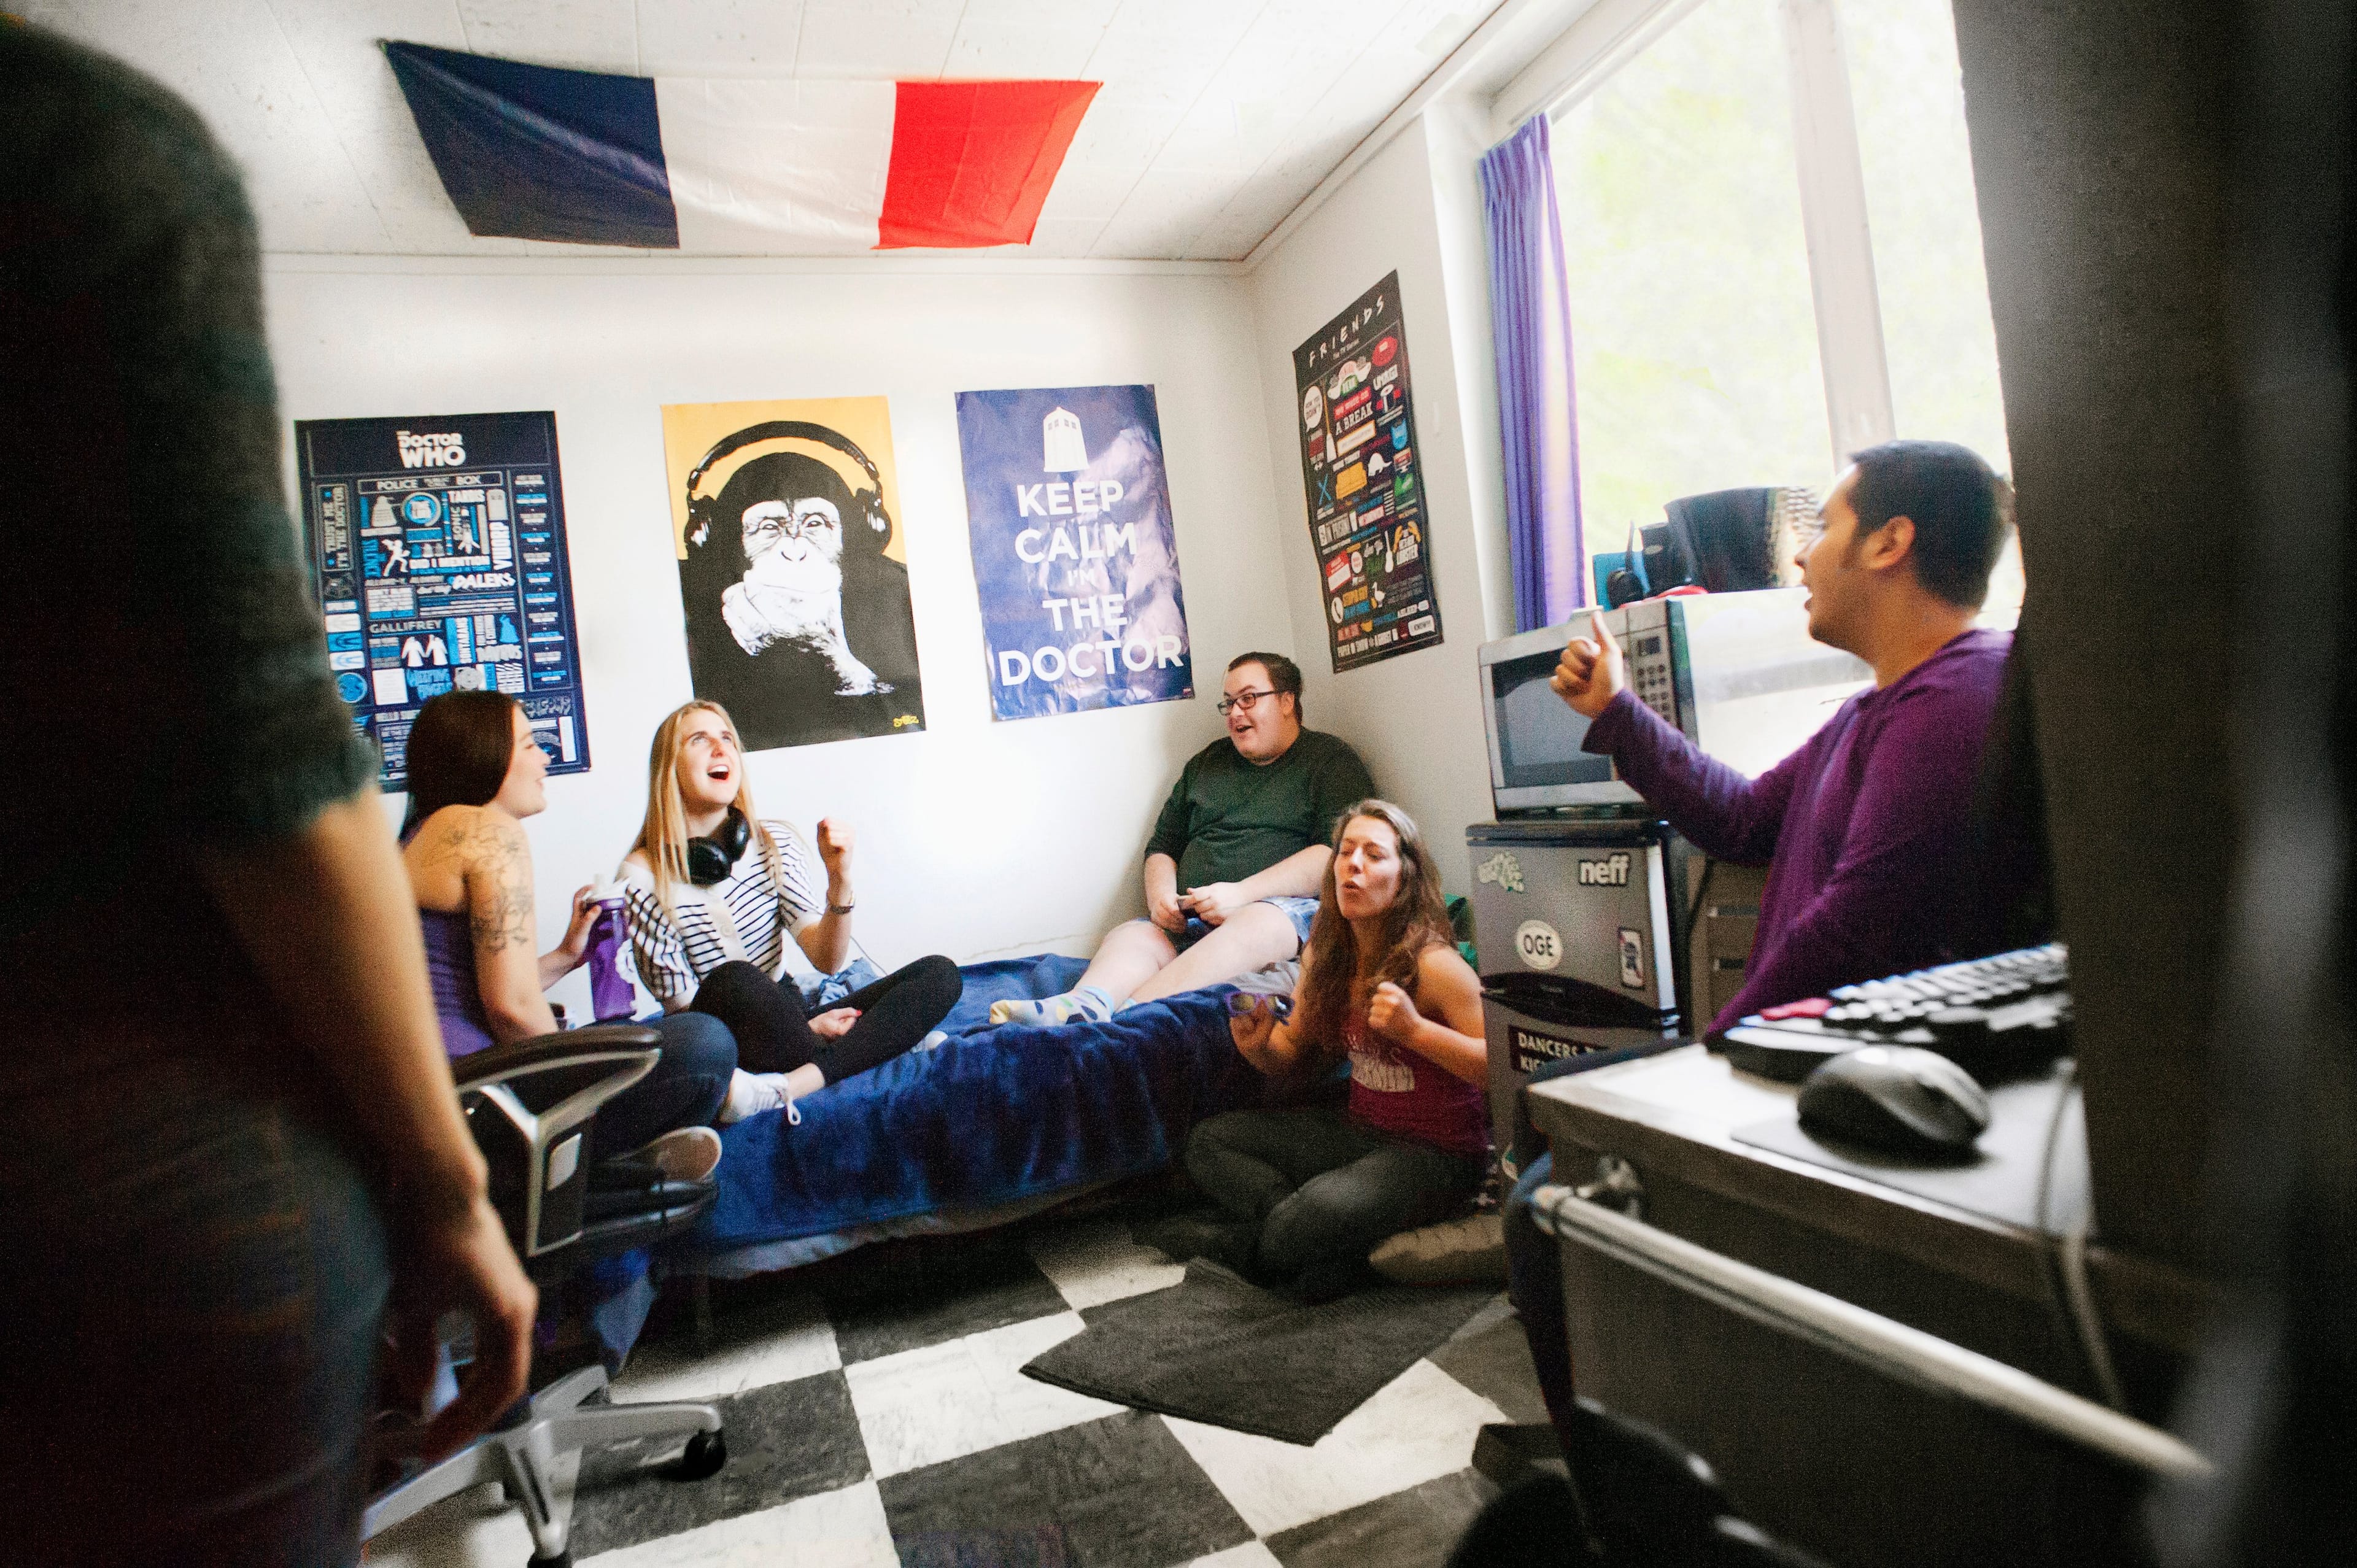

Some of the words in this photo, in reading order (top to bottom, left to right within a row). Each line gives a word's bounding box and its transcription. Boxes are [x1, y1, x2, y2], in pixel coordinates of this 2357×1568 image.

[1309, 295, 1385, 368] FRIENDS
[1336, 422, 1342, 435] A
[1343, 401, 1374, 430] BREAK
[397, 433, 463, 448] DOCTOR
[399, 446, 466, 468] WHO
[377, 479, 419, 492] POLICE
[456, 476, 481, 485] BOX
[1016, 480, 1124, 517] KEEP
[1015, 522, 1137, 564] CALM
[452, 572, 516, 590] DALEKS
[1067, 568, 1095, 587] I'M
[1042, 593, 1128, 632] THE
[370, 620, 442, 633] GALLIFREY
[998, 635, 1185, 687] DOCTOR
[1580, 854, 1630, 886] neff
[1523, 933, 1554, 957] OGE
[1517, 1032, 1578, 1059] DANCERS
